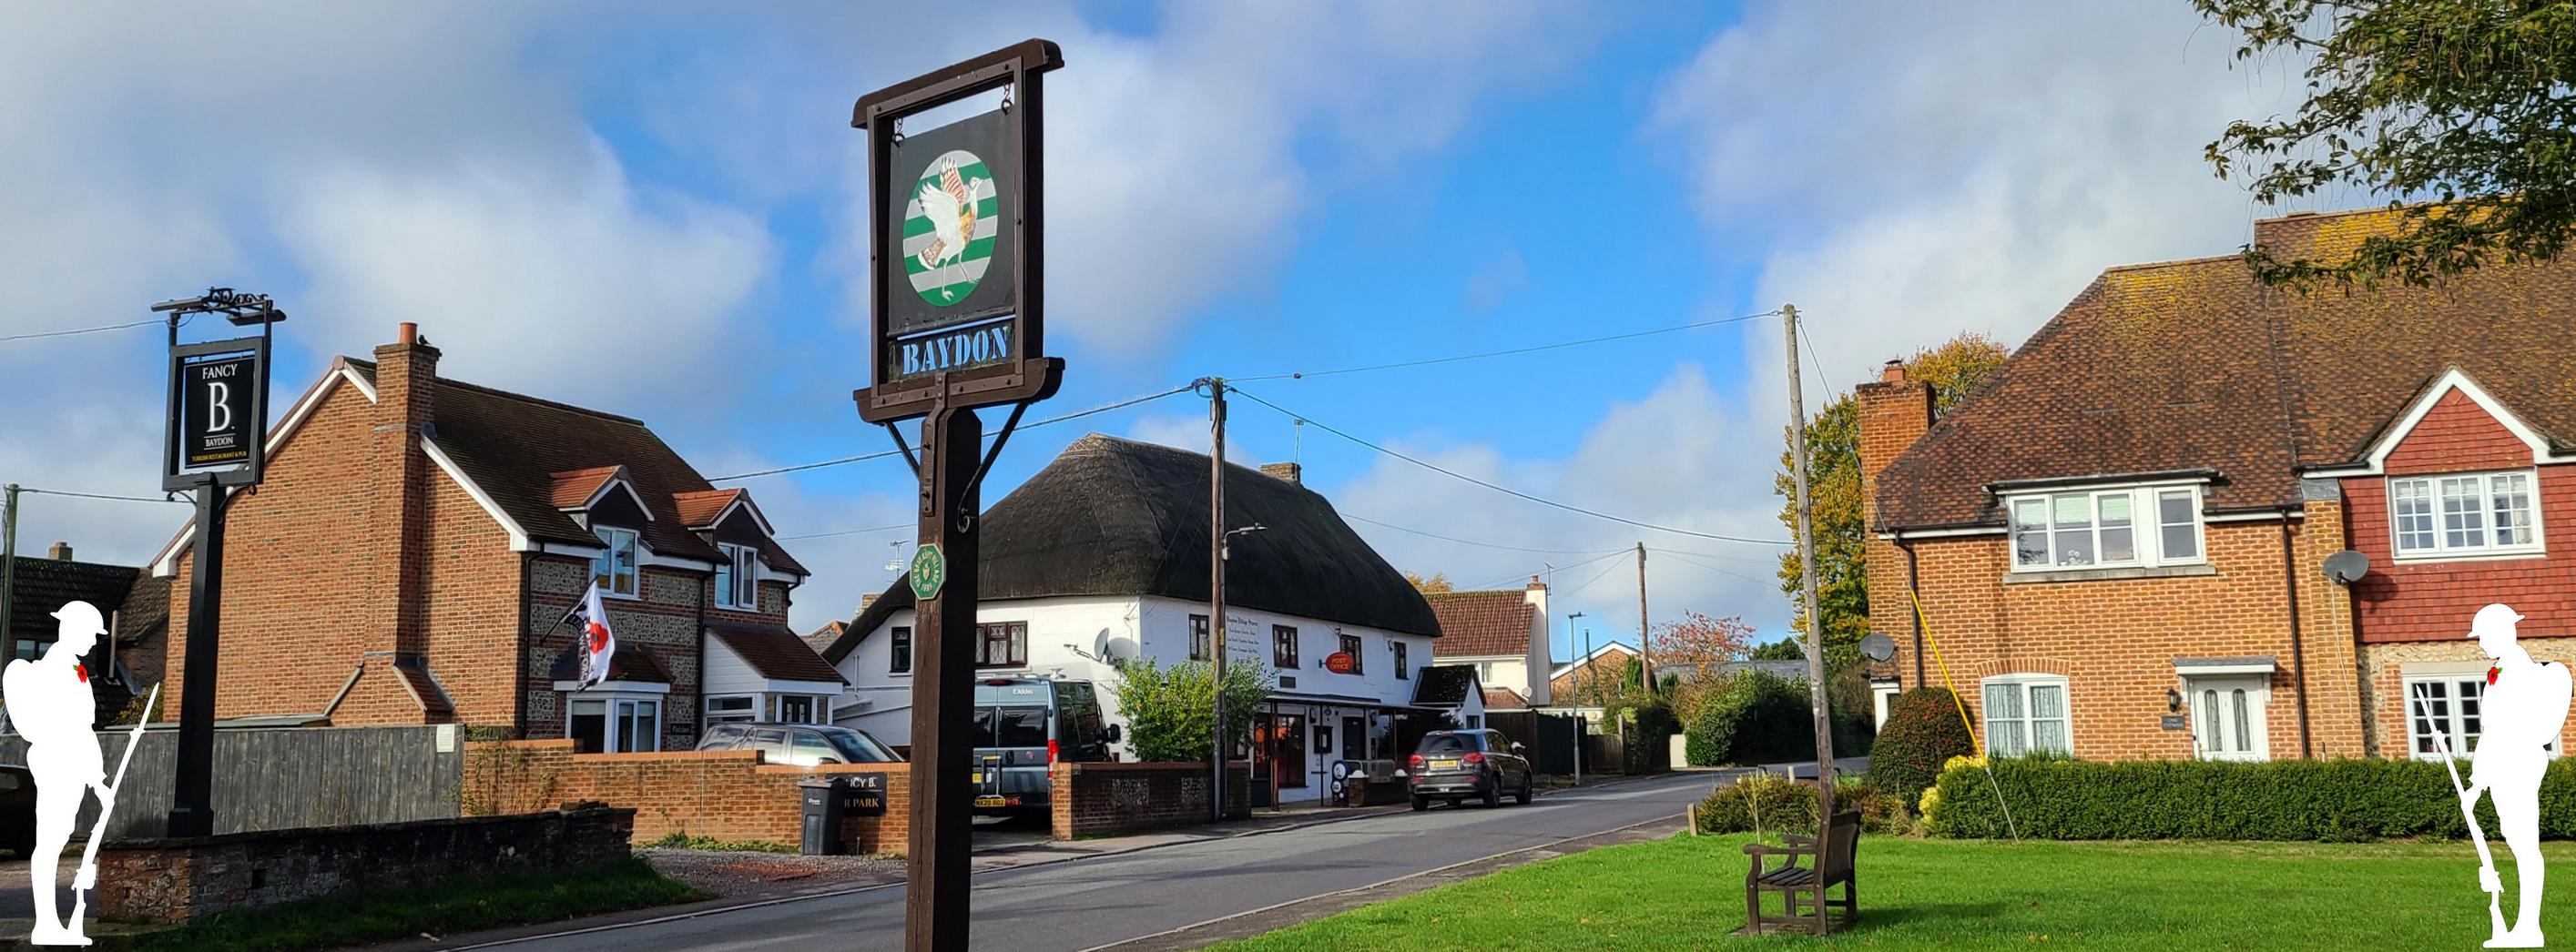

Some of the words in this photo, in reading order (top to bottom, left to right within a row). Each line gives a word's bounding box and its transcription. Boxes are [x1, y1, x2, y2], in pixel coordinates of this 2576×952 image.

[902, 326, 1008, 375] BAYDON
[202, 364, 237, 380] FANCY
[206, 381, 235, 432] B.
[206, 437, 233, 447] BAYDON
[853, 797, 880, 808] PARK
